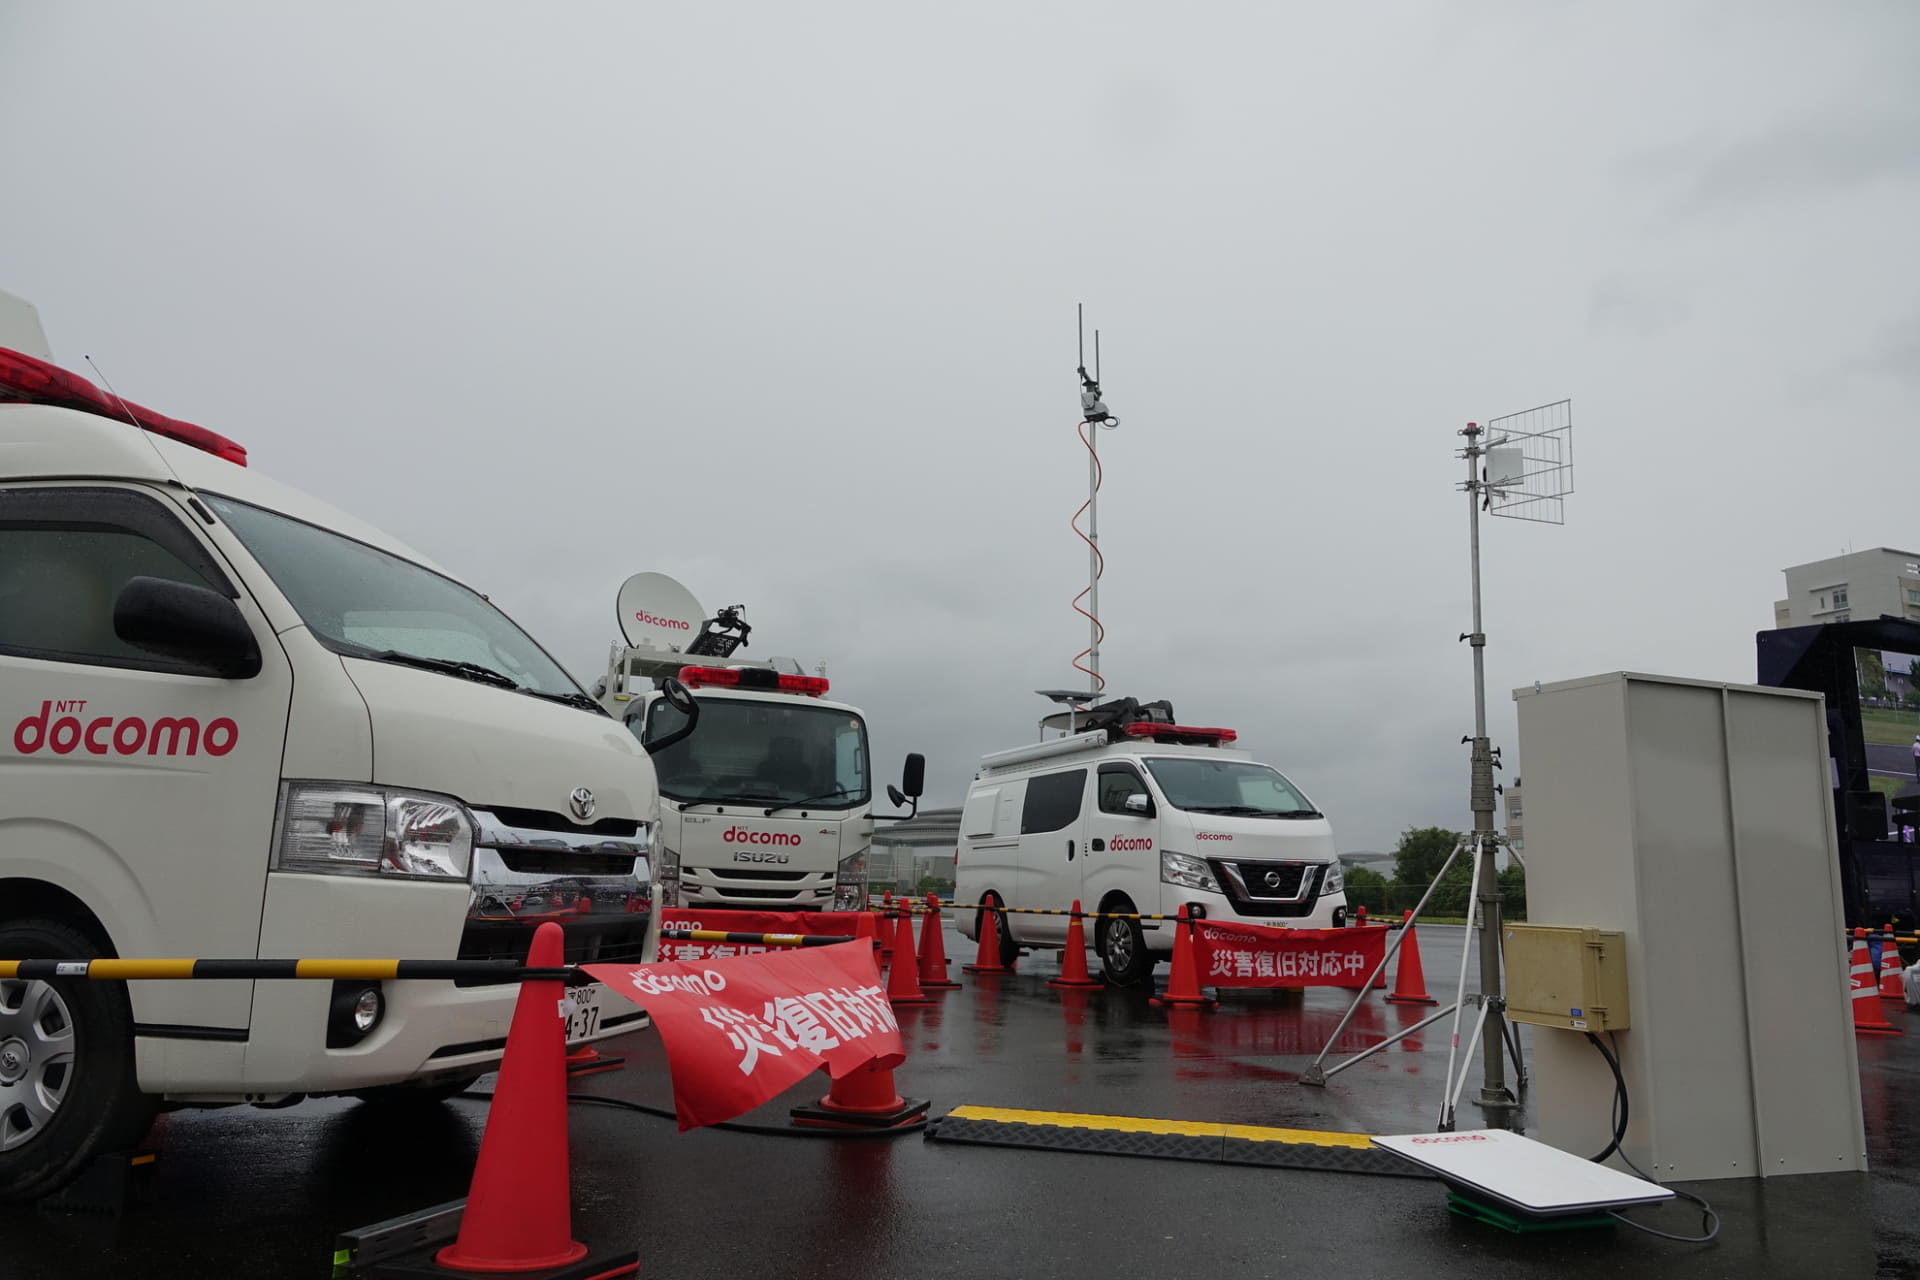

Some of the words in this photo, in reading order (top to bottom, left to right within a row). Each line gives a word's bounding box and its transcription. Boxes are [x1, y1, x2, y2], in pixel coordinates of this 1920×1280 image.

[636, 609, 690, 630] docomo
[56, 700, 87, 713] NTT
[14, 700, 239, 757] docomo
[723, 825, 802, 847] docomo
[1110, 834, 1152, 851] docomo
[1196, 832, 1233, 841] docomo
[733, 852, 790, 864] ISUZU
[1203, 927, 1257, 943] docomo
[1209, 949, 1365, 978] 災害復旧対応中
